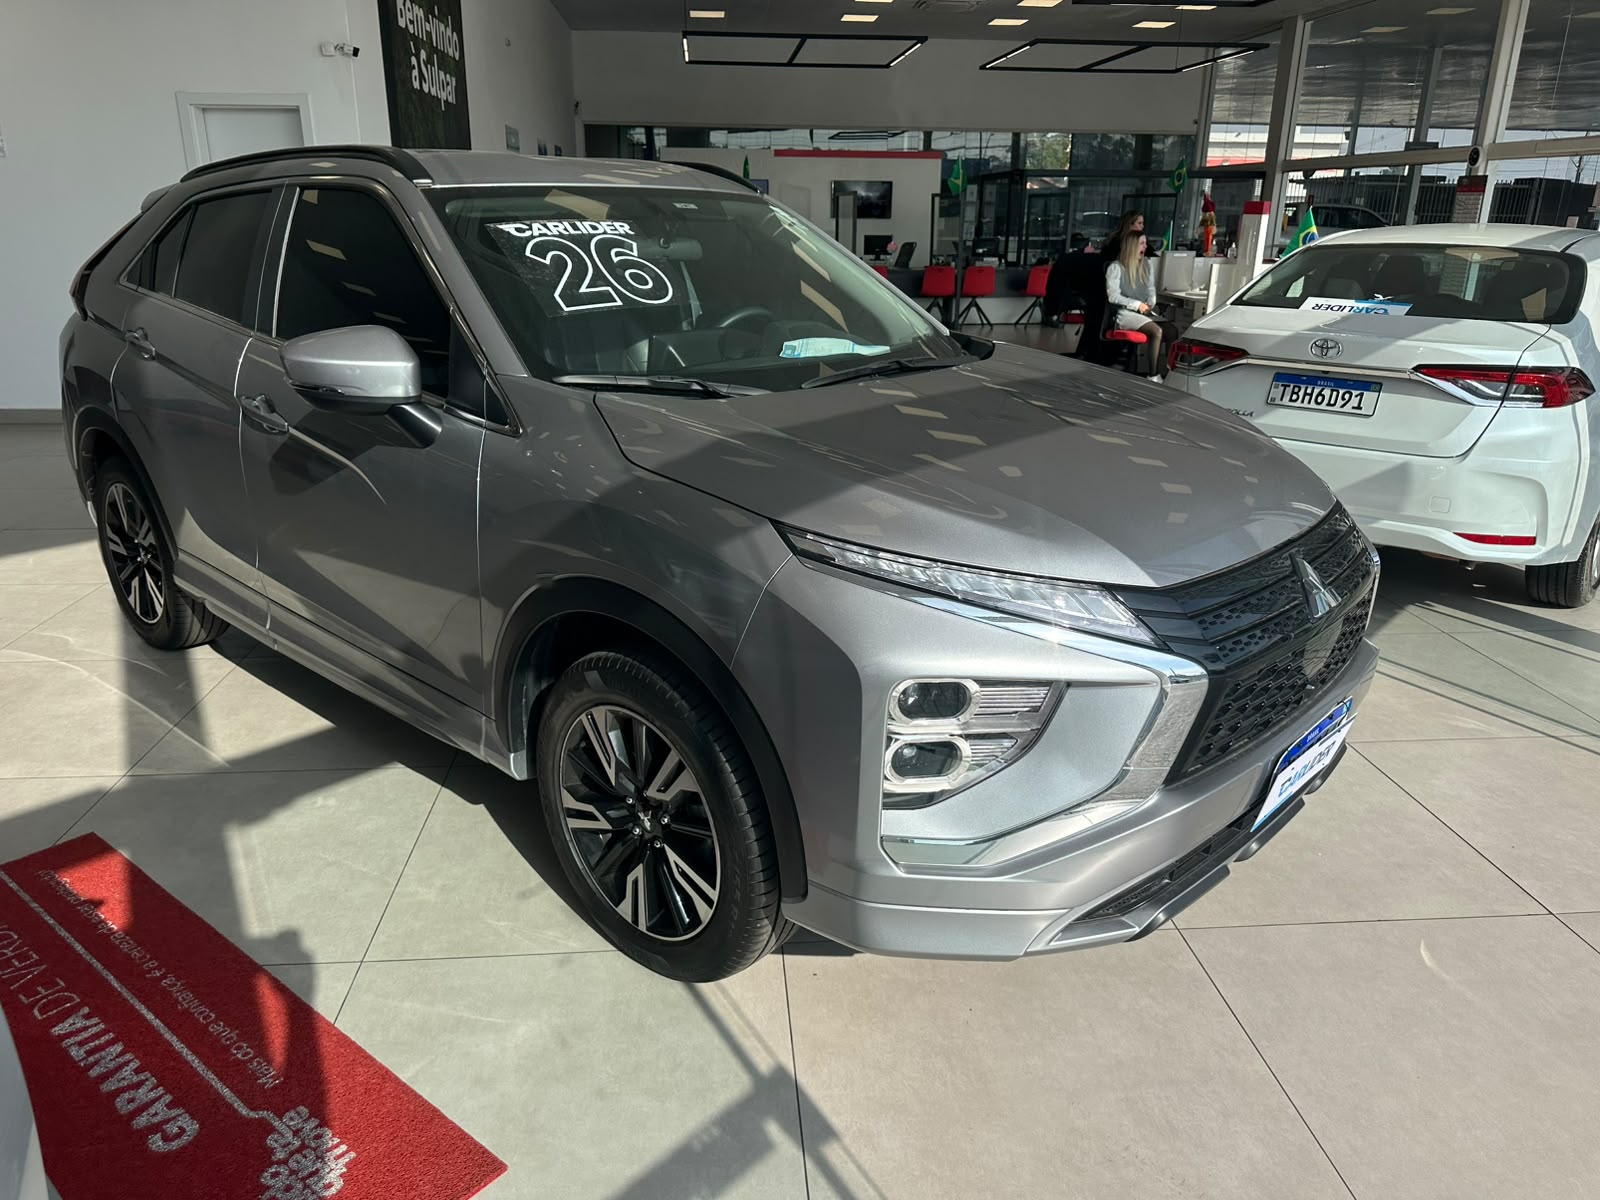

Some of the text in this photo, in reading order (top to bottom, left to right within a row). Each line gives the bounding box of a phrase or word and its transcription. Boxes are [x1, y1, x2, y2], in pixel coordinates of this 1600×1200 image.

[396, 0, 460, 61] Bem-vindo
[410, 41, 456, 111] à Sulpar
[497, 221, 635, 237] CARLIDER
[525, 234, 673, 311] 26
[1312, 303, 1389, 315] CARLIDER
[1279, 383, 1365, 410] TBH6D91
[18, 977, 80, 1020] DE
[208, 1020, 239, 1045] que
[230, 1042, 253, 1060] do
[51, 1006, 199, 1152] GARANTIA
[248, 1057, 284, 1089] Mais
[282, 1105, 357, 1170] move
